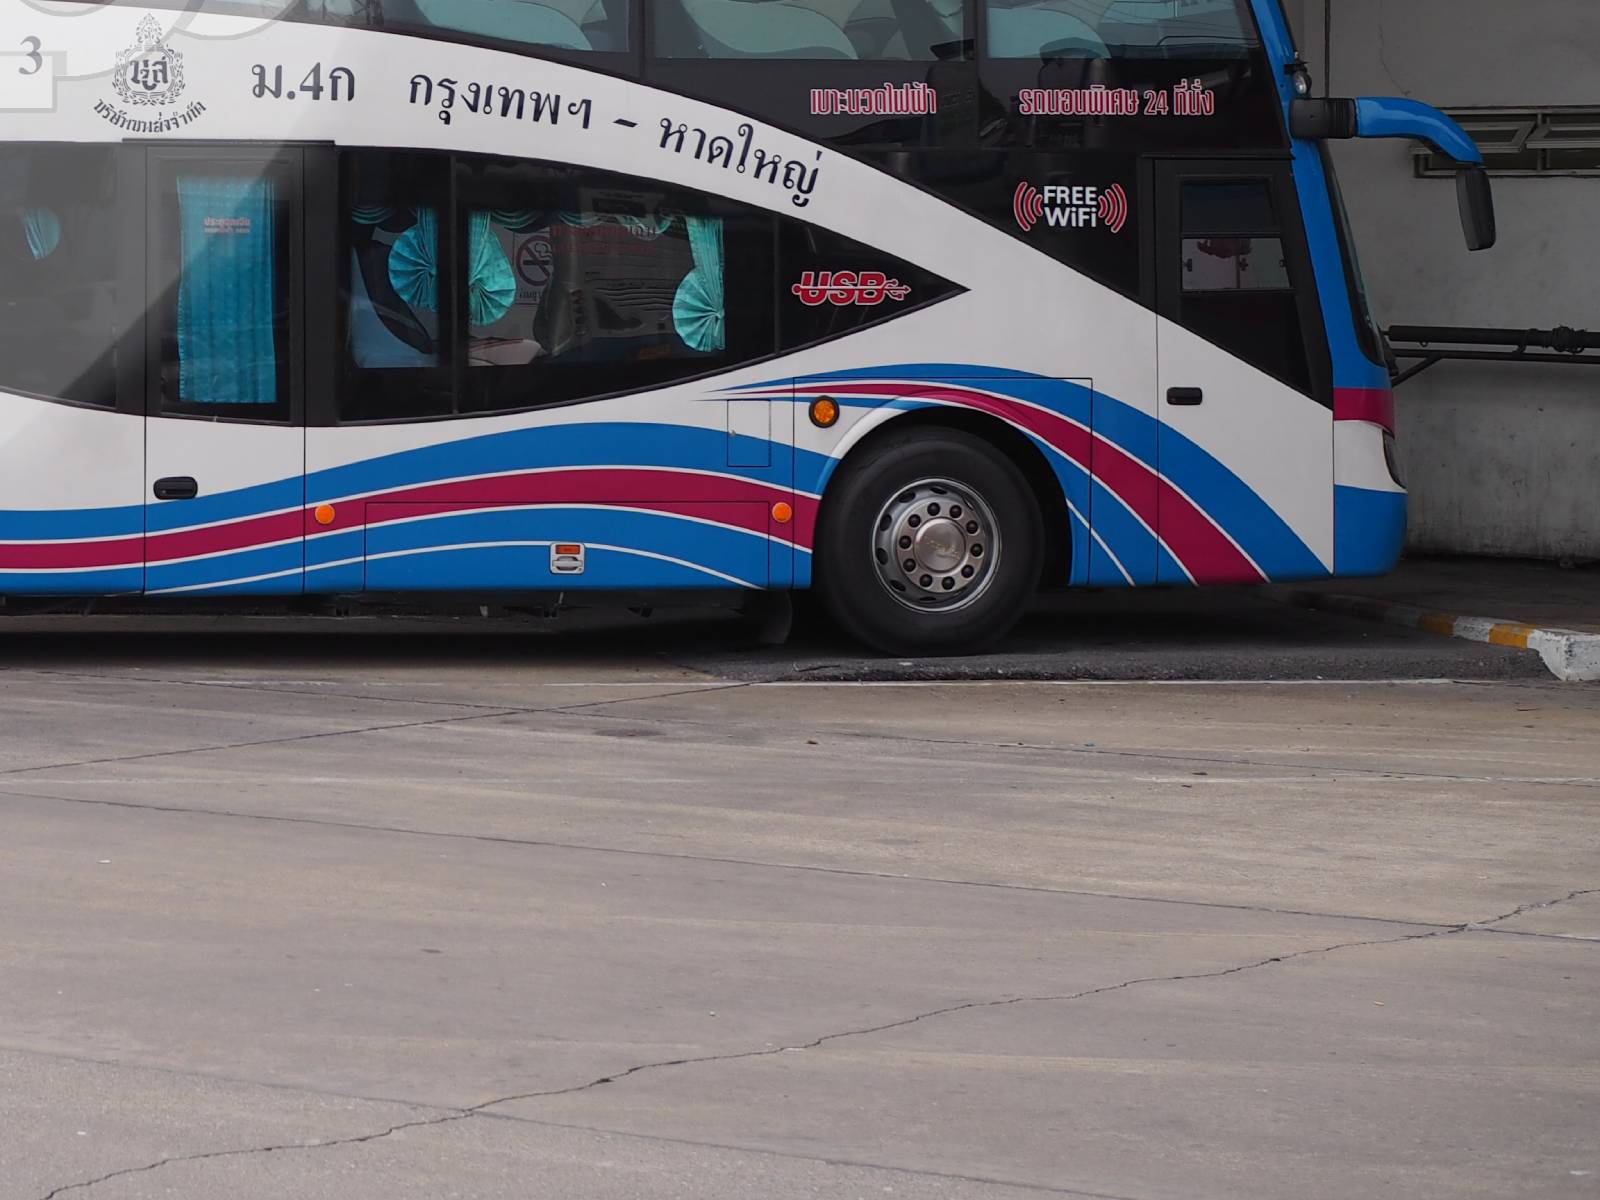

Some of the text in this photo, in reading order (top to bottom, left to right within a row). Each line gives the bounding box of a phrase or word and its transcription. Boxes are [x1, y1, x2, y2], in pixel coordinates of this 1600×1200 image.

[18, 35, 43, 76] 3
[251, 61, 356, 102] ม.4ก
[810, 81, 937, 115] เบาะนวดไฟฟ้า
[1018, 78, 1215, 116] รถนอนพิเศษ 24 ที่นั่ง
[408, 72, 593, 127] กรุงเทพฯ
[657, 115, 823, 208] หาดใหญ่
[1043, 185, 1098, 204] FREE
[1043, 206, 1098, 228] WiFi
[797, 271, 896, 306] USB
